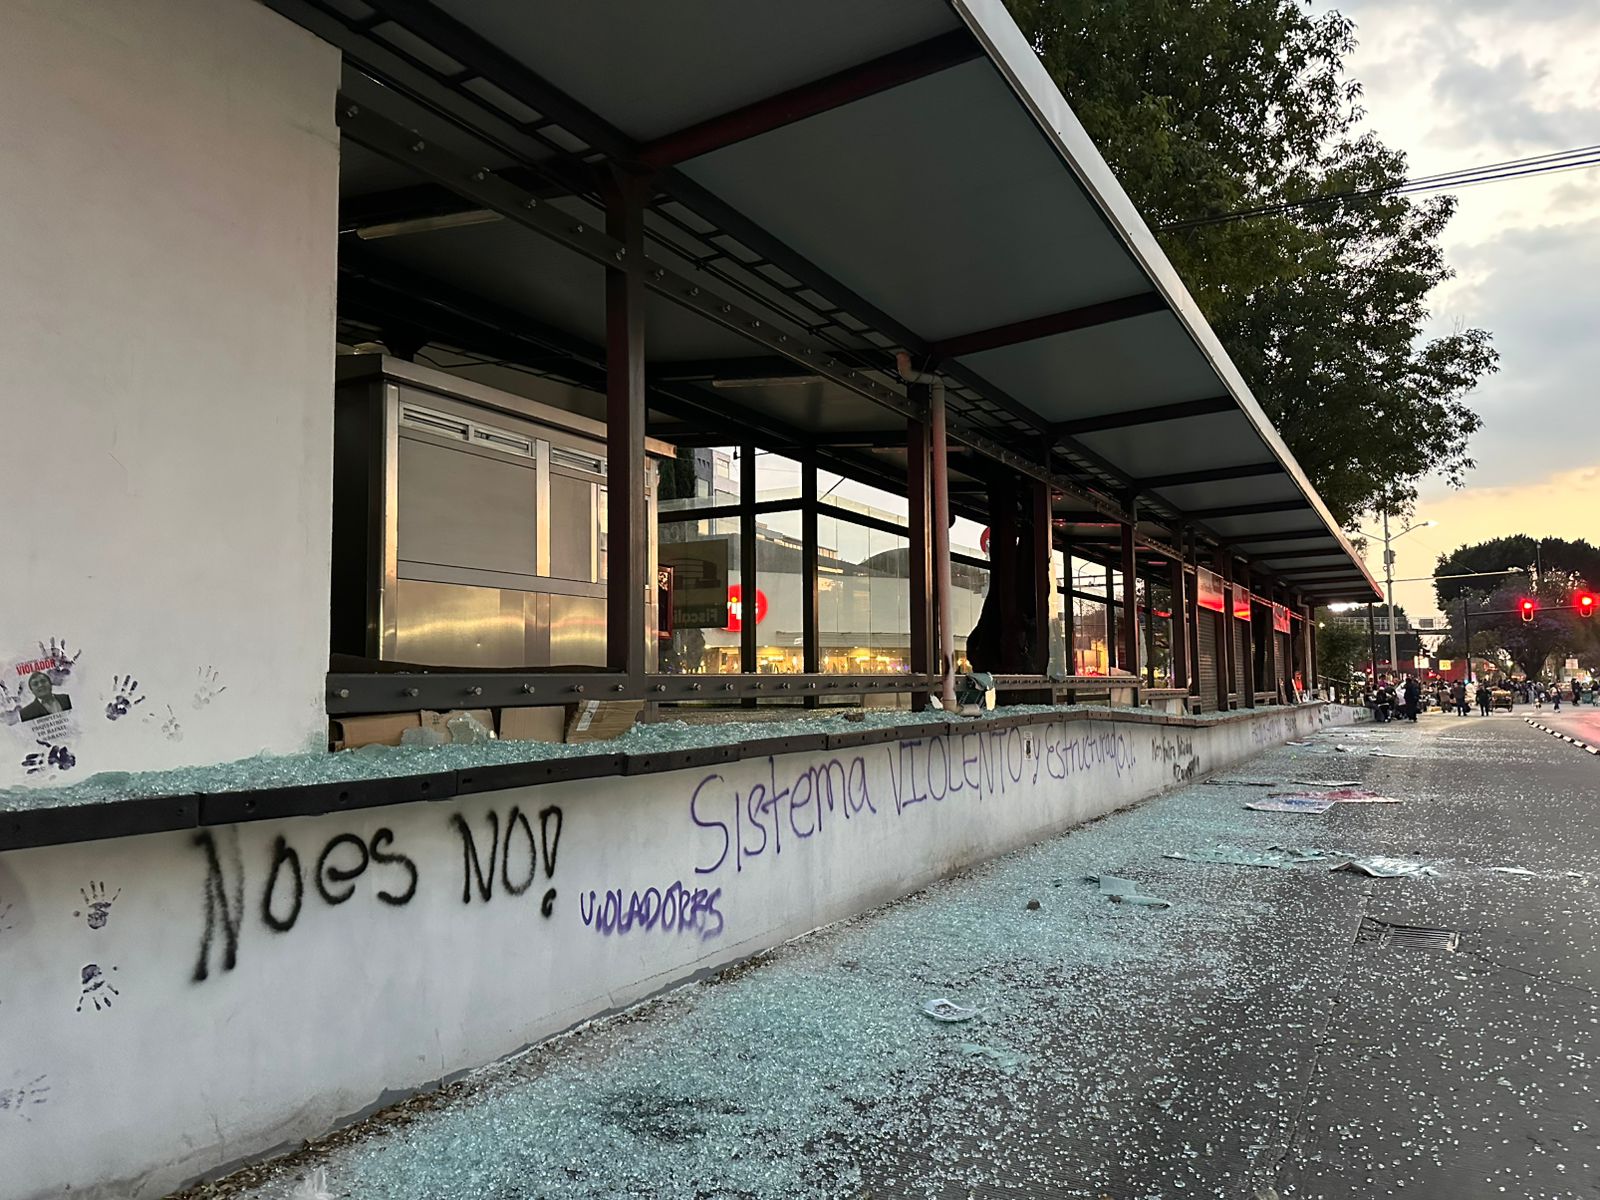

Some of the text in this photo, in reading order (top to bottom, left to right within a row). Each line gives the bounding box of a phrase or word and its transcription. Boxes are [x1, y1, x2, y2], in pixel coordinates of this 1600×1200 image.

[16, 658, 56, 676] VIOLADOR
[886, 725, 1023, 816] VIOLENTO
[449, 804, 563, 918] NO!
